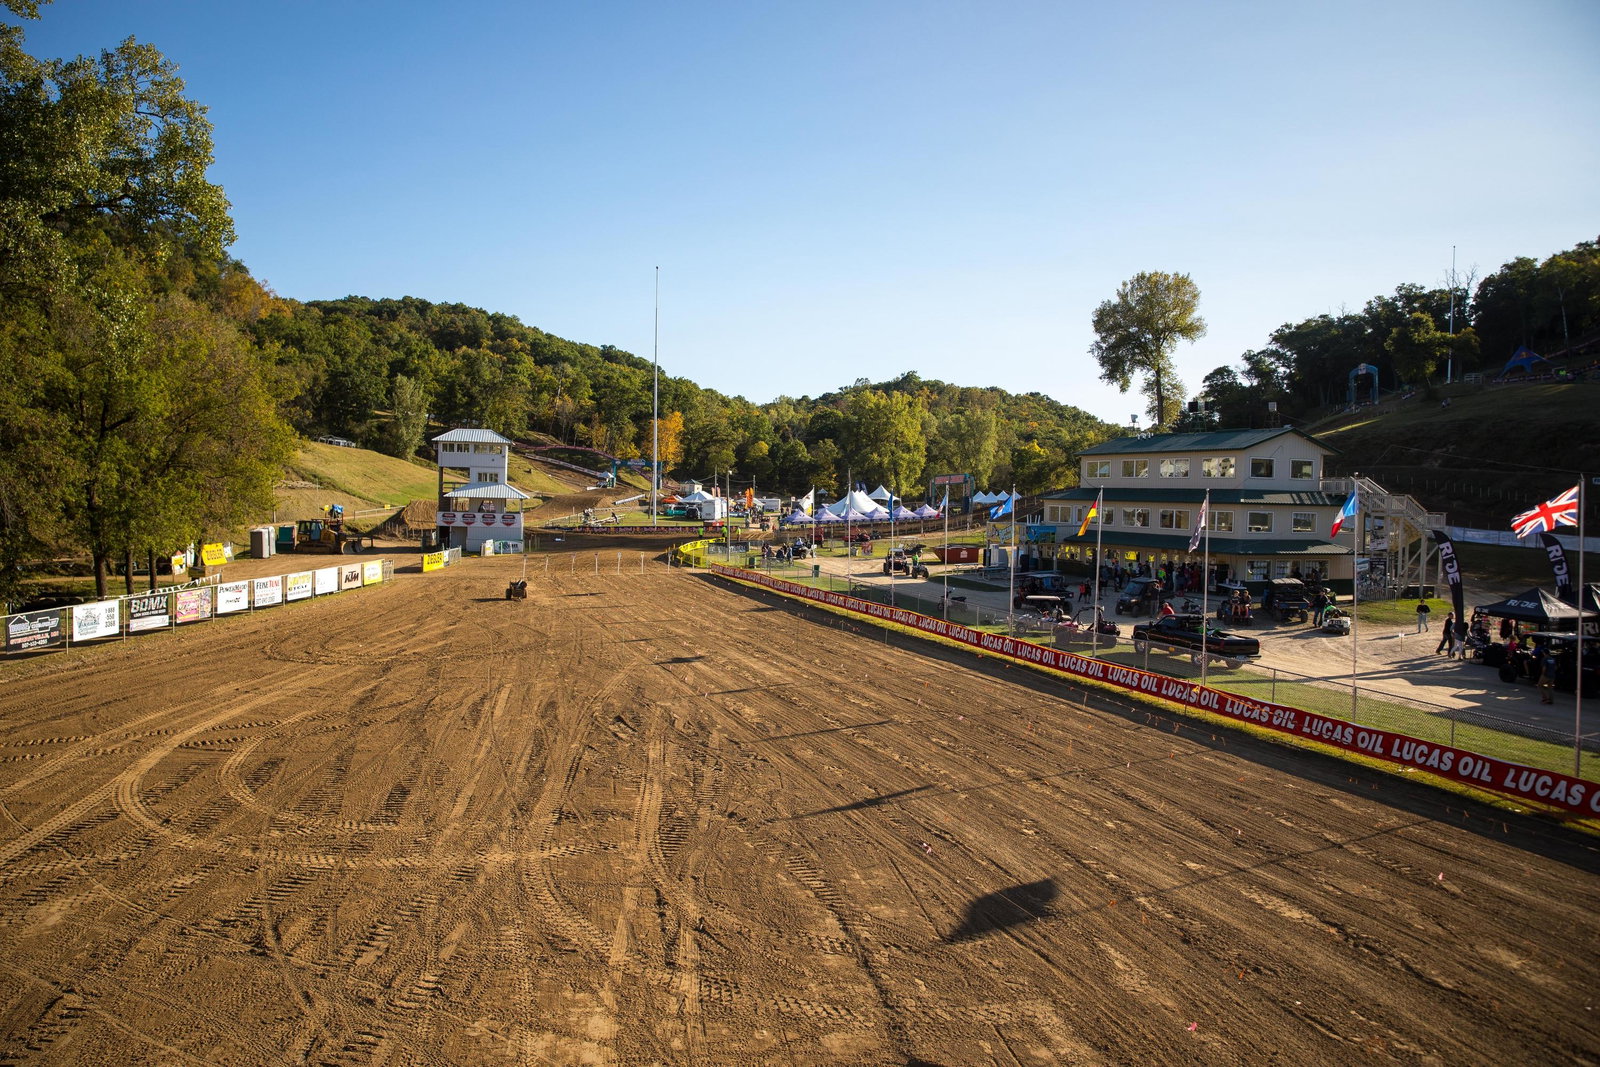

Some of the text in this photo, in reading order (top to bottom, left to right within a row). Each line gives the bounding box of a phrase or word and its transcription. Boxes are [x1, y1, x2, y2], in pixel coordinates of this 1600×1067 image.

[1439, 541, 1461, 585] RIDE
[1547, 544, 1569, 587] RIDE
[344, 570, 359, 583] KTM
[808, 588, 819, 599] LUCAS
[826, 593, 838, 603] LUCAS
[846, 598, 858, 610] LUCAS
[1506, 599, 1539, 609] RIDE
[868, 603, 882, 616] LUCAS
[892, 609, 908, 622] LUCAS
[918, 616, 946, 633] LUCAS OIL
[949, 625, 977, 643] LUCAS OIL
[981, 633, 1014, 654] LUCAS OIL
[1017, 644, 1055, 665] LUCAS OIL
[1059, 654, 1103, 677] LUCAS OIL
[1108, 667, 1157, 692] LUCAS OIL
[1162, 680, 1219, 709] LUCAS OIL
[1225, 698, 1295, 730] LUCAS OIL
[1302, 716, 1384, 754] LUCAS OIL
[1391, 738, 1492, 782] LUCAS OIL
[1503, 768, 1586, 807] LUCAS
